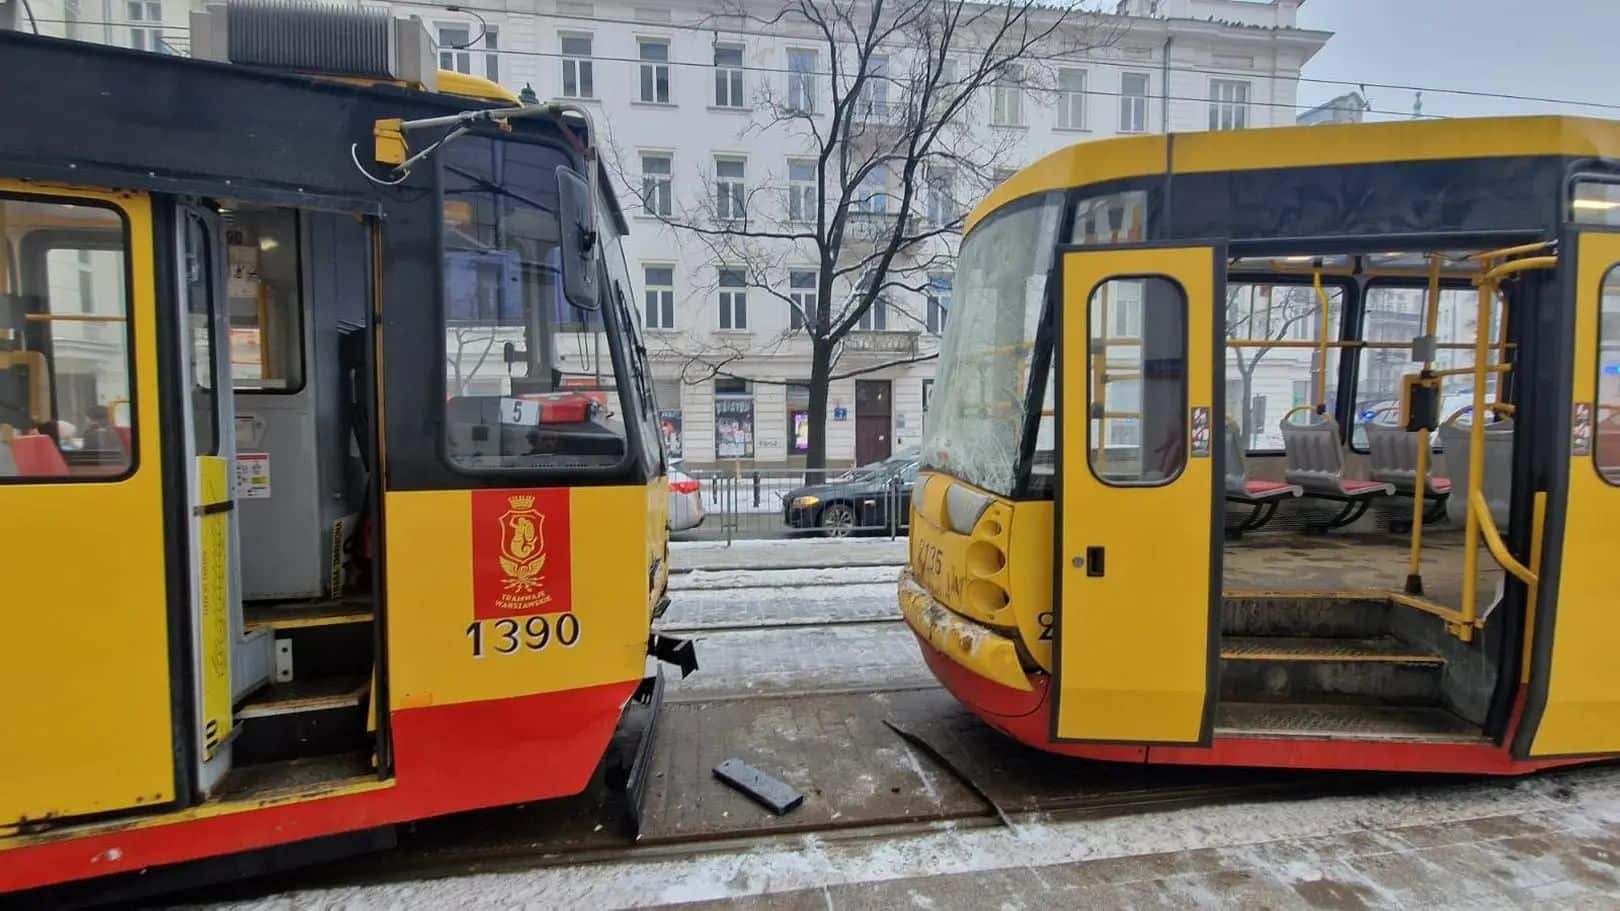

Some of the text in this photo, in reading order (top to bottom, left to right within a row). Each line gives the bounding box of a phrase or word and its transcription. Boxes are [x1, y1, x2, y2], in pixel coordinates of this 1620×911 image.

[513, 401, 522, 422] 5
[495, 595, 553, 609] WARSZAWSKIE
[502, 591, 546, 602] TRAMWAJE
[465, 613, 580, 658] 1390
